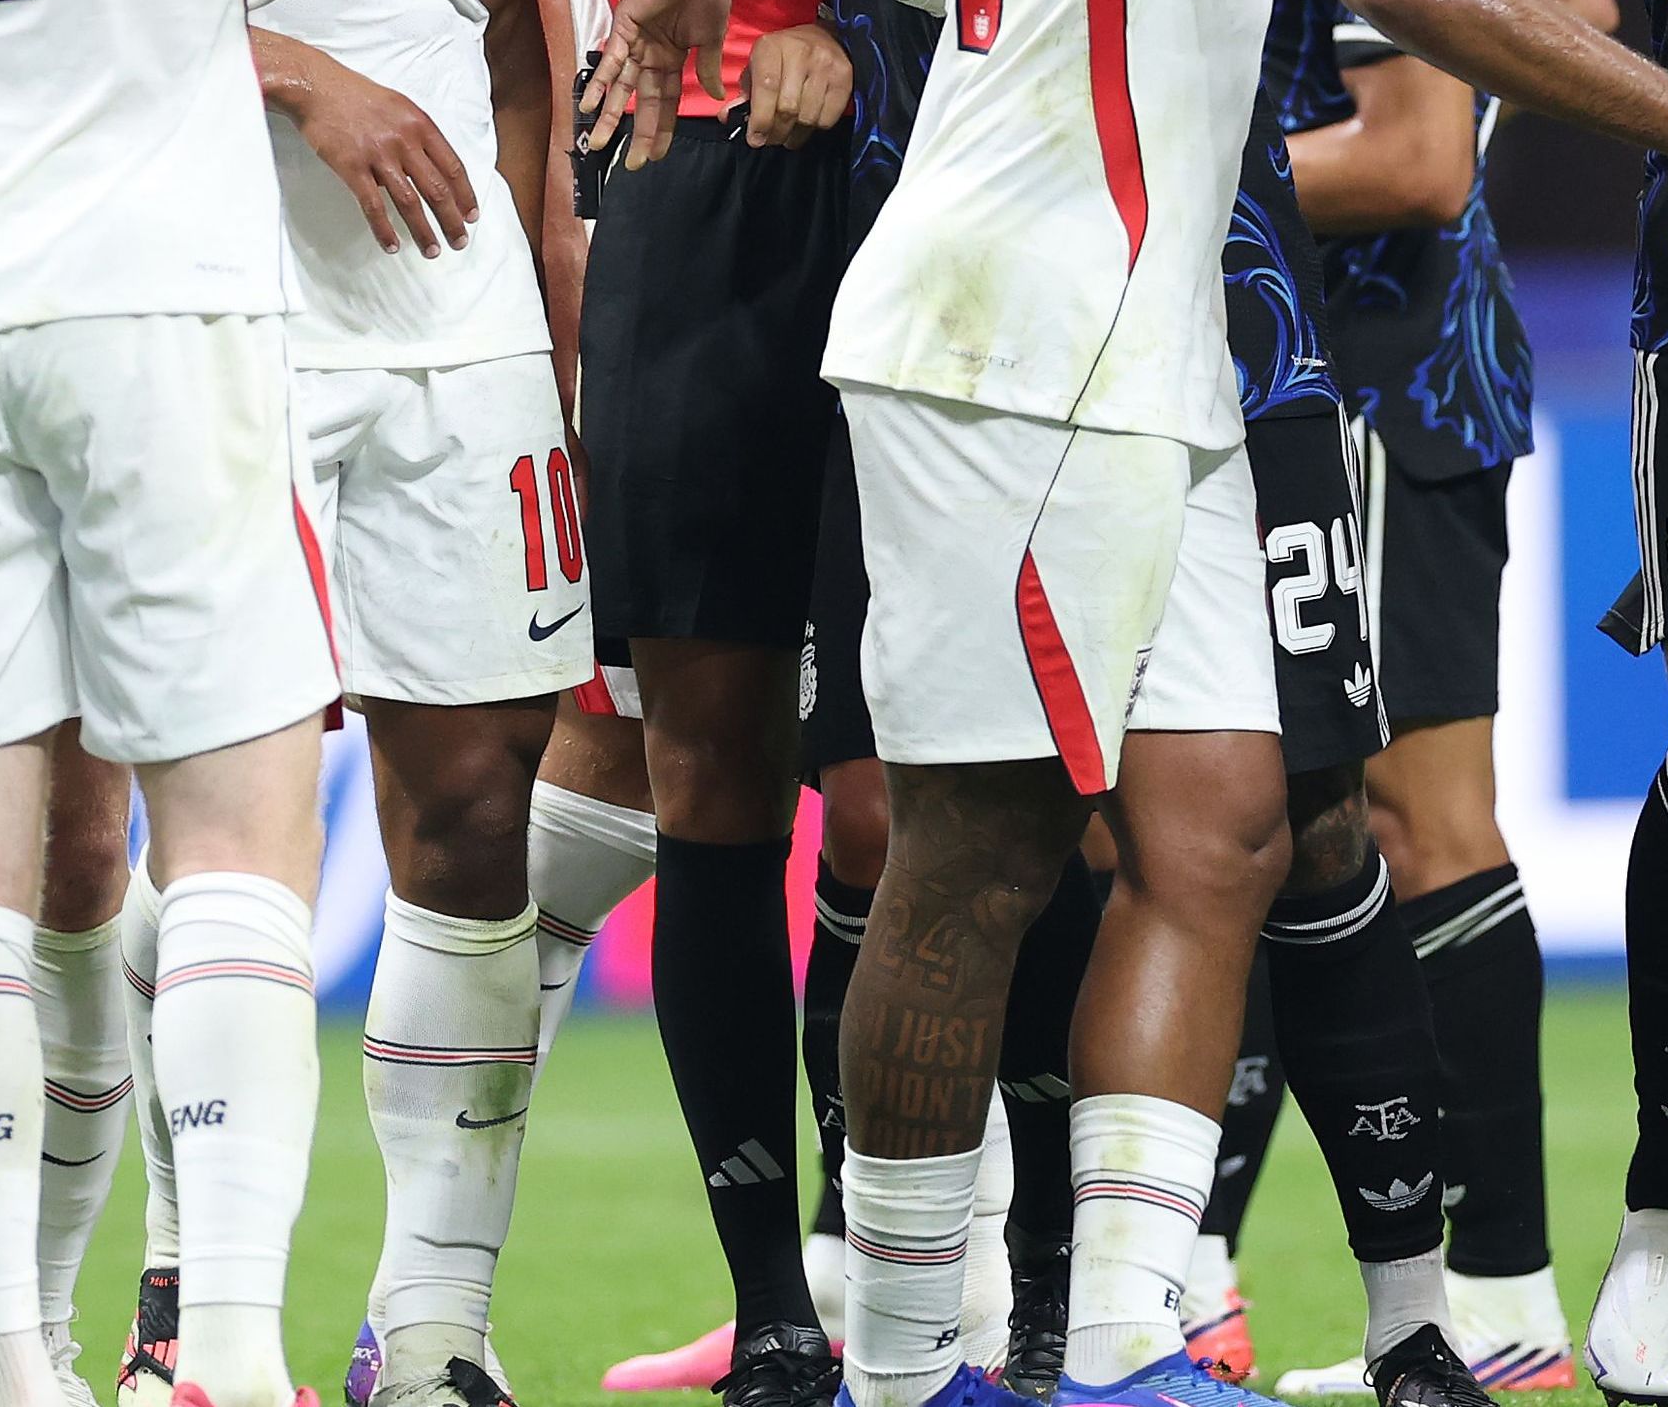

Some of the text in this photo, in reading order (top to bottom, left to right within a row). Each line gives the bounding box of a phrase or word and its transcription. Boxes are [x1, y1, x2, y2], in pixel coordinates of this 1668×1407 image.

[509, 447, 584, 592] 10
[1265, 521, 1369, 655] 24
[893, 1008, 990, 1068] JUST
[169, 1099, 226, 1138] ENG
[1348, 1096, 1421, 1142] AFA
